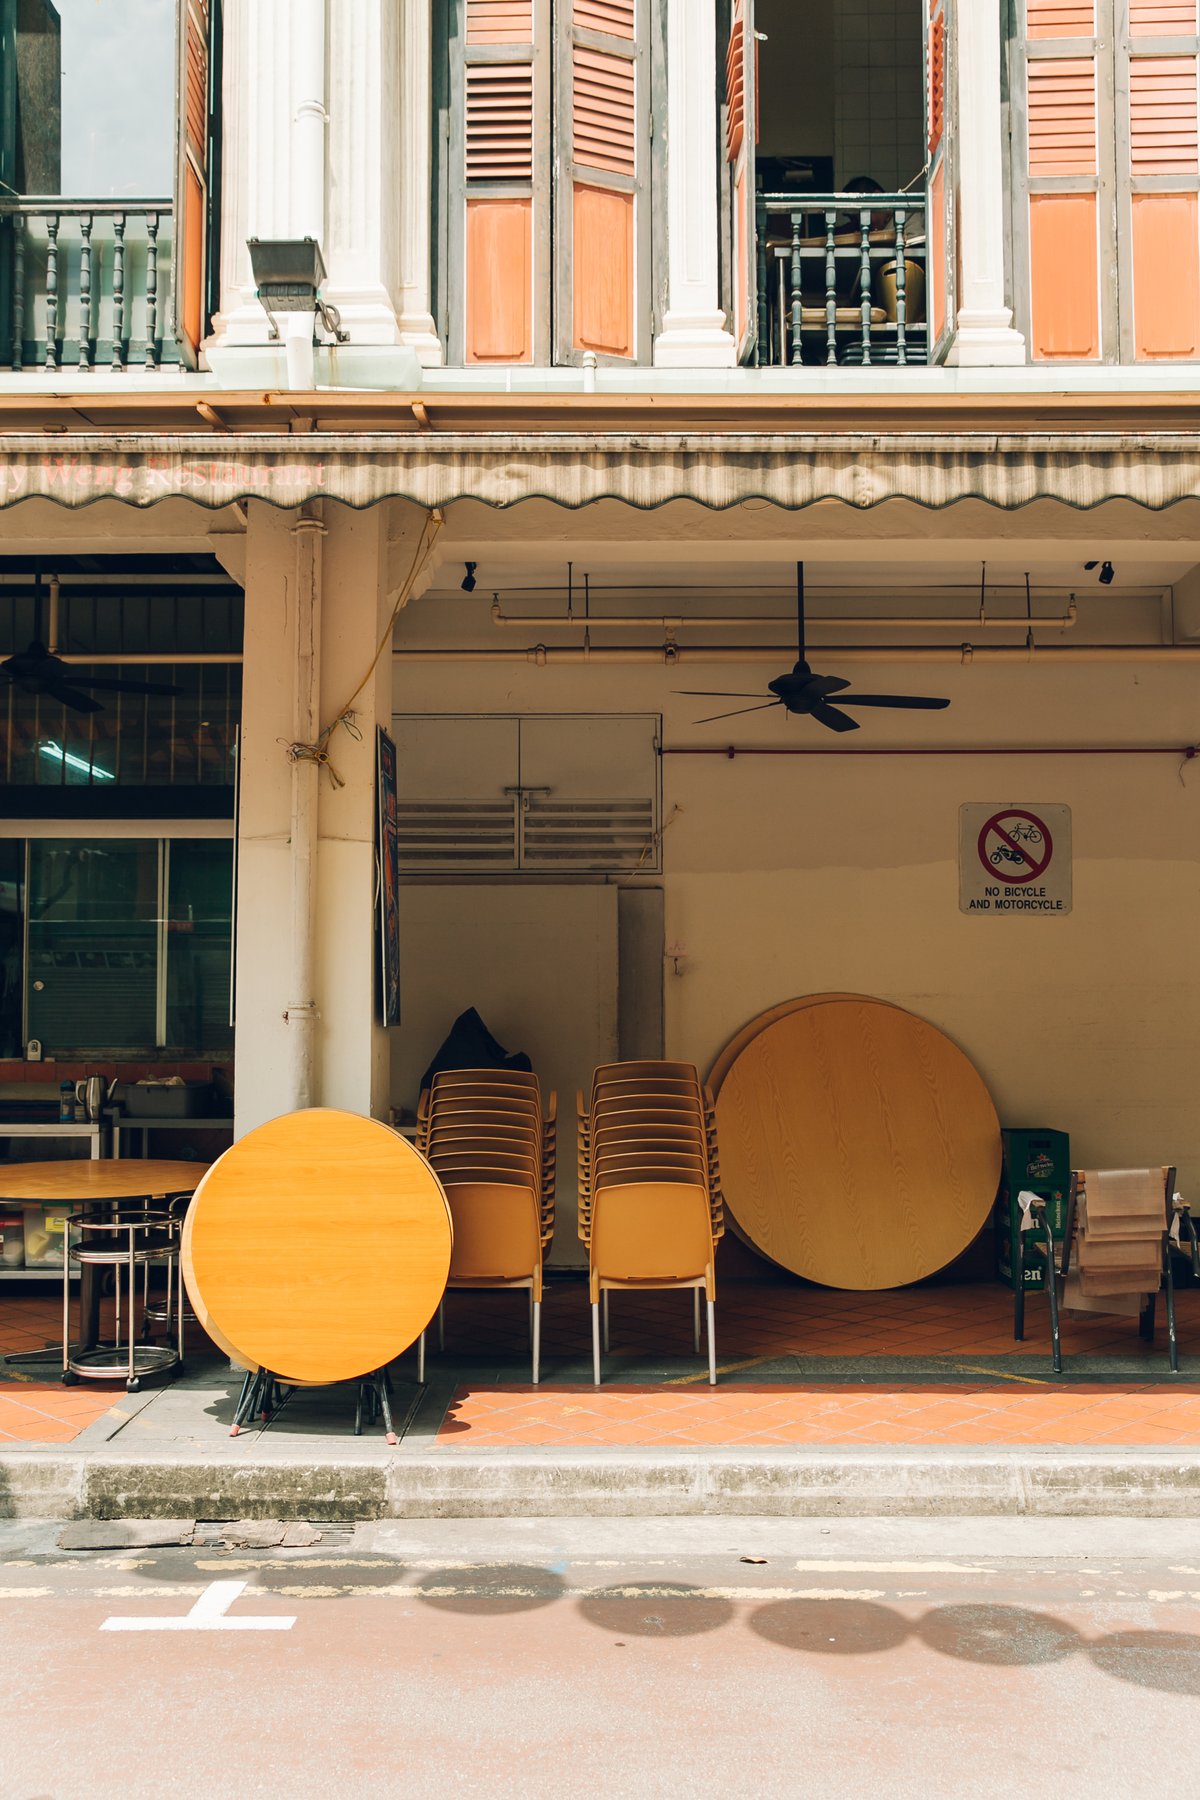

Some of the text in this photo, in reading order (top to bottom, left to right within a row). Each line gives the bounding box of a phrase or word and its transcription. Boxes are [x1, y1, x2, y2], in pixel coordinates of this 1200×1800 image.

[41, 457, 134, 495] Weng
[146, 457, 326, 487] Restaurant
[985, 887, 1047, 897] NO BICYCLE
[969, 899, 1063, 909] AND MOTORCYCLE
